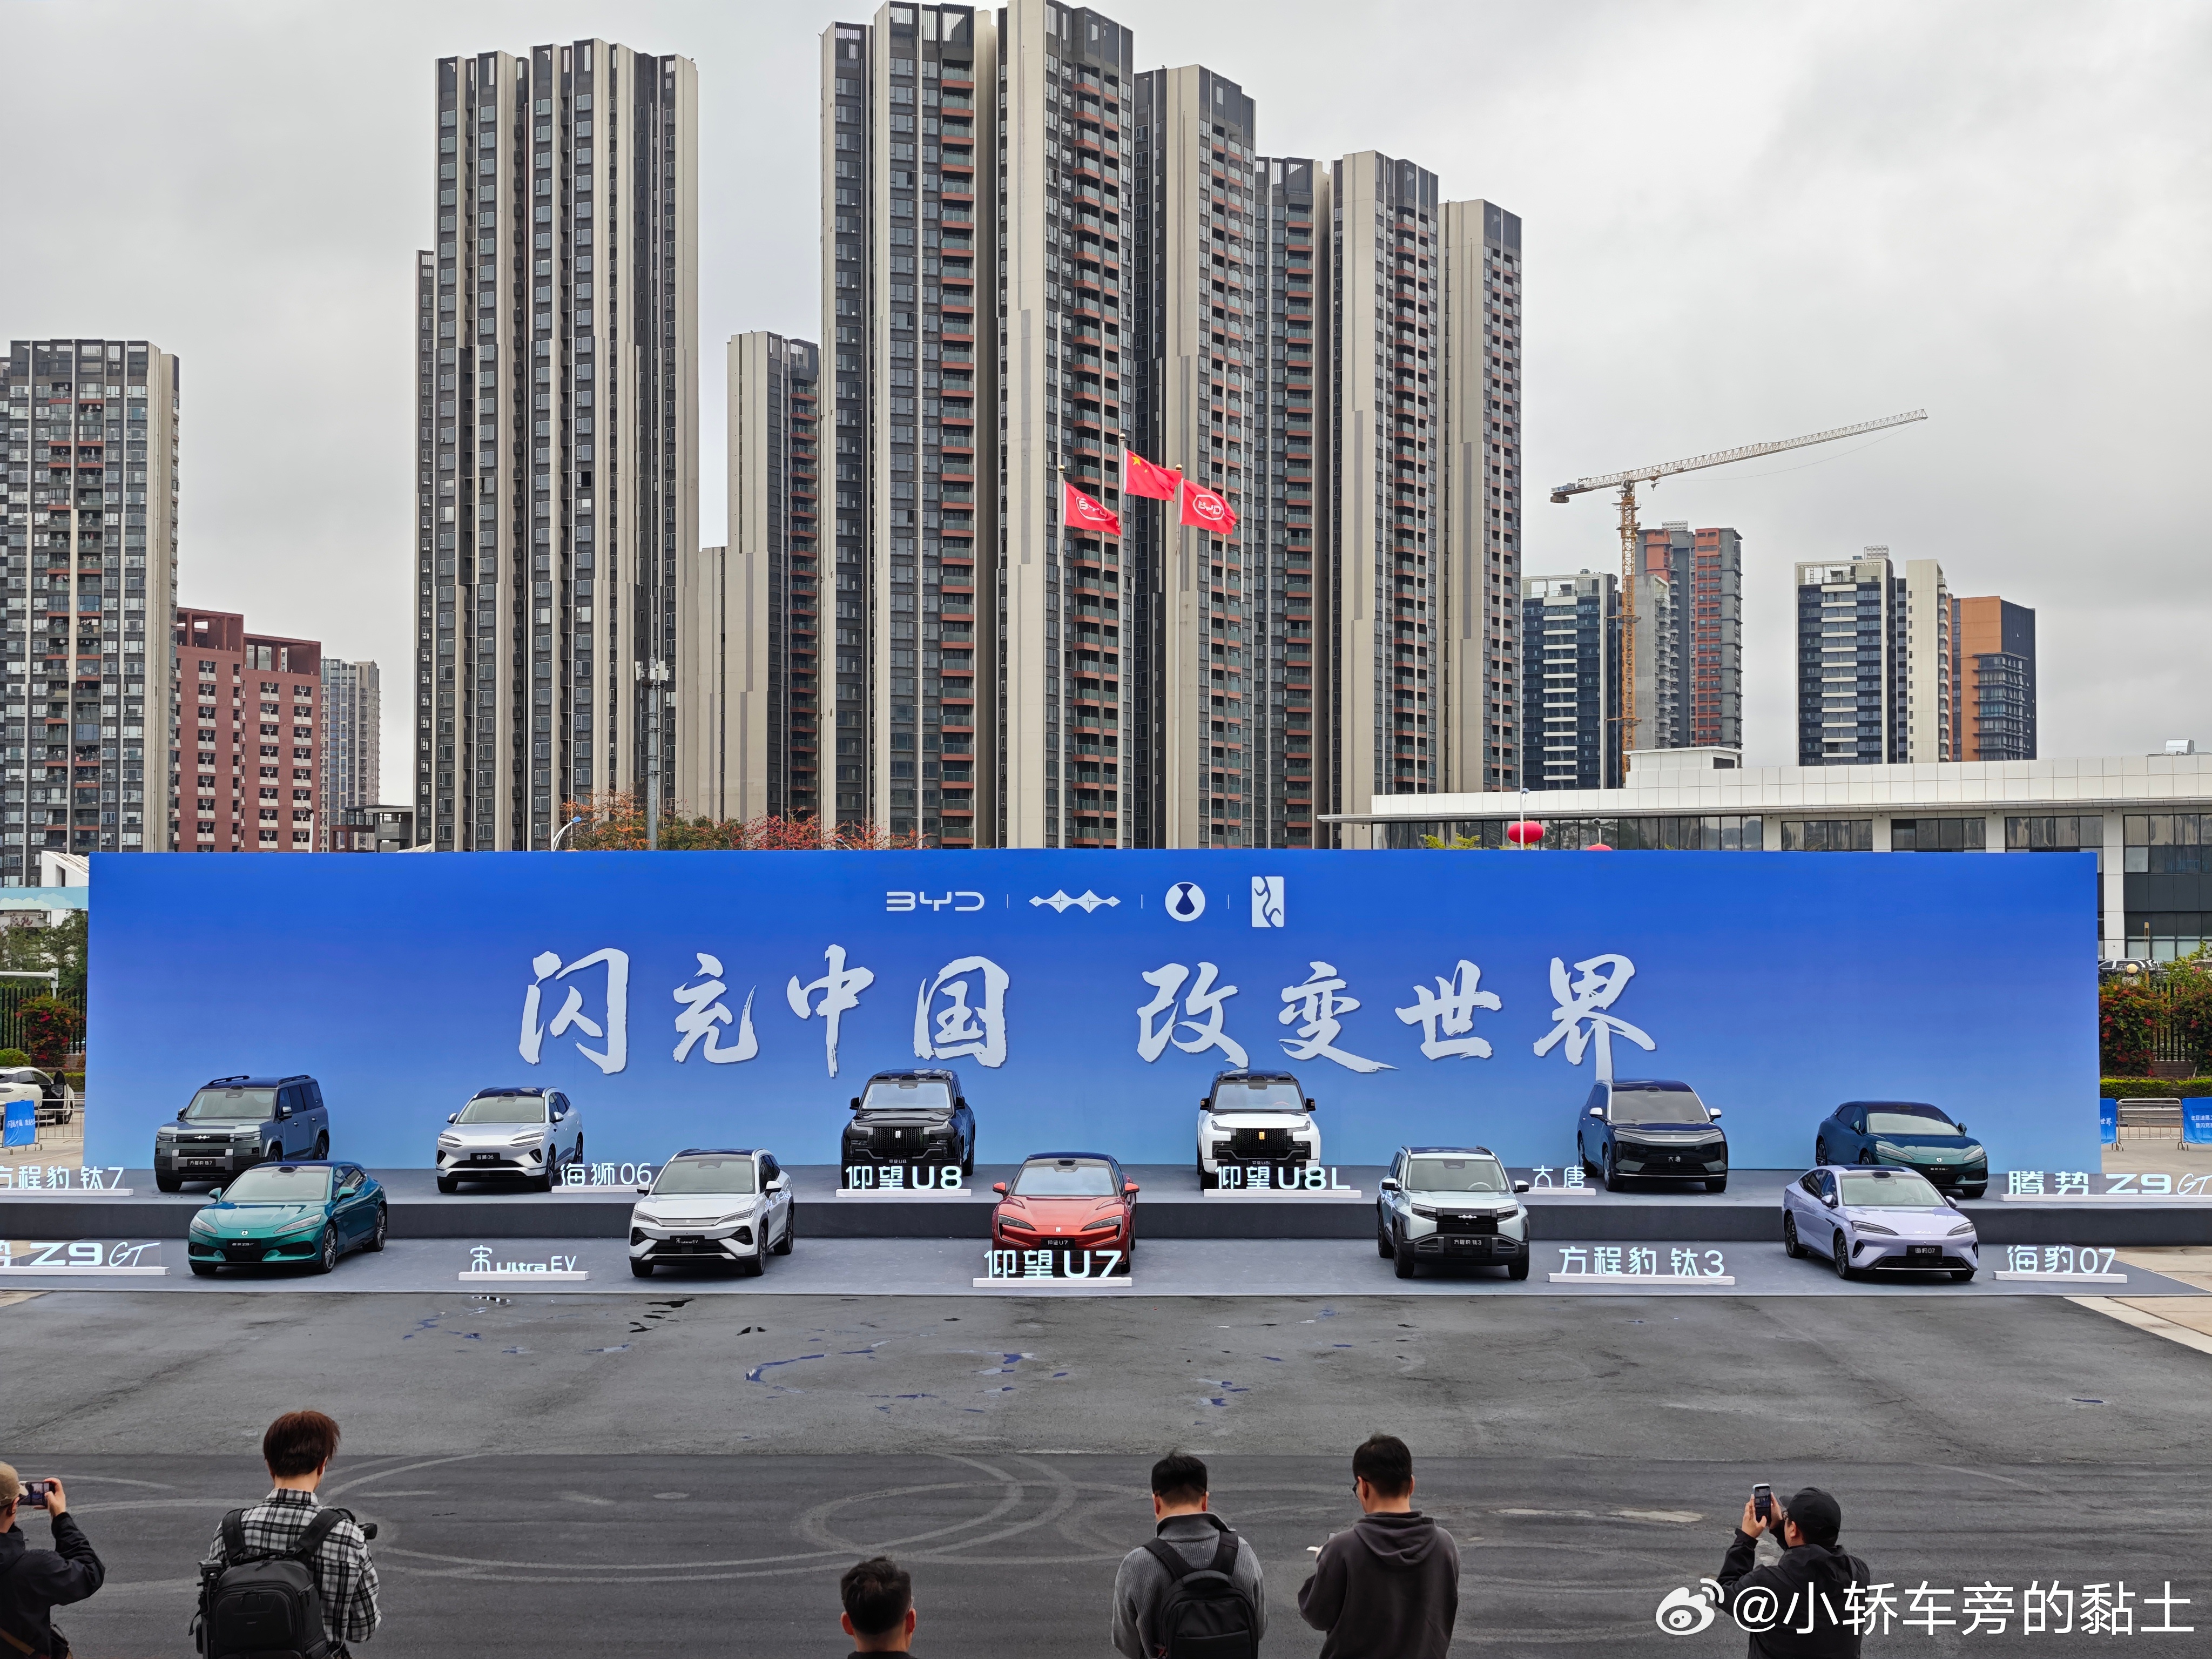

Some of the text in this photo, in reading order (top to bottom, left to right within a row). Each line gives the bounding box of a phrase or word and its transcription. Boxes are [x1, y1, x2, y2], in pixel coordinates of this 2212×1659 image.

[886, 892, 984, 911] BYD
[518, 943, 1656, 1081] 闪充中国 改变世界
[80, 1166, 124, 1189] 钛7
[1533, 1165, 1586, 1188] 大唐
[551, 1256, 577, 1272] EV
[1559, 1246, 1724, 1277] 方程豹 钛3
